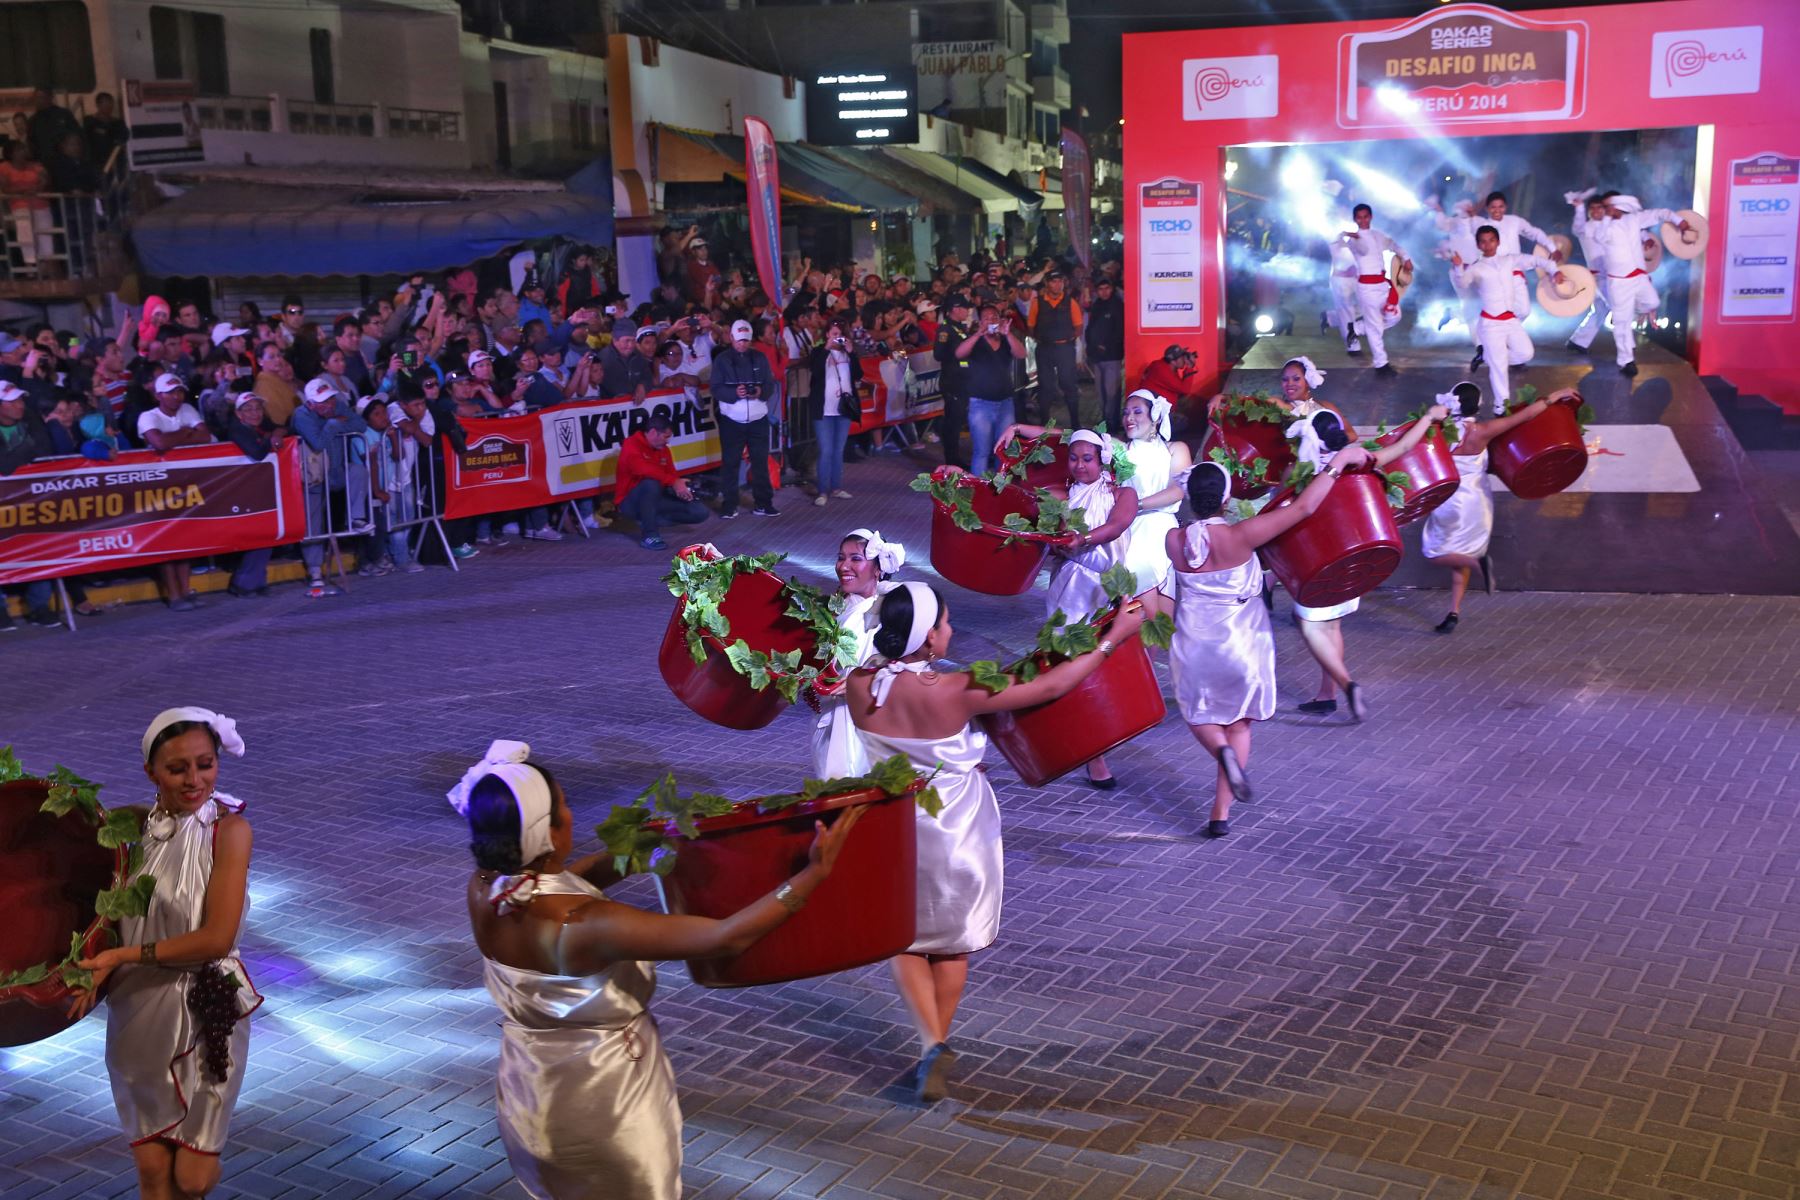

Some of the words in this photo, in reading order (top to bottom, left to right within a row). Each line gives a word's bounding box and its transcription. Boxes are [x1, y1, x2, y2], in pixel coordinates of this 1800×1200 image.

[1431, 25, 1493, 39] DAKAR
[921, 42, 995, 55] RESTAURANT
[1431, 37, 1493, 50] SERIES
[919, 56, 955, 76] JUAN
[960, 54, 1005, 74] PABLO
[1385, 54, 1476, 78] DESAFIO
[1483, 52, 1537, 73] INCA
[1469, 94, 1508, 110] 2014
[1740, 199, 1790, 213] TECHO
[1149, 219, 1193, 232] TECHO
[579, 396, 717, 453] KÄRHE
[466, 455, 500, 466] DESAFIO
[501, 452, 518, 463] INCA
[31, 476, 98, 494] DAKAR
[105, 469, 168, 486] SERIES
[0, 492, 124, 529] DESAFIO
[134, 484, 206, 514] INCA
[79, 530, 134, 553] PERÚ
